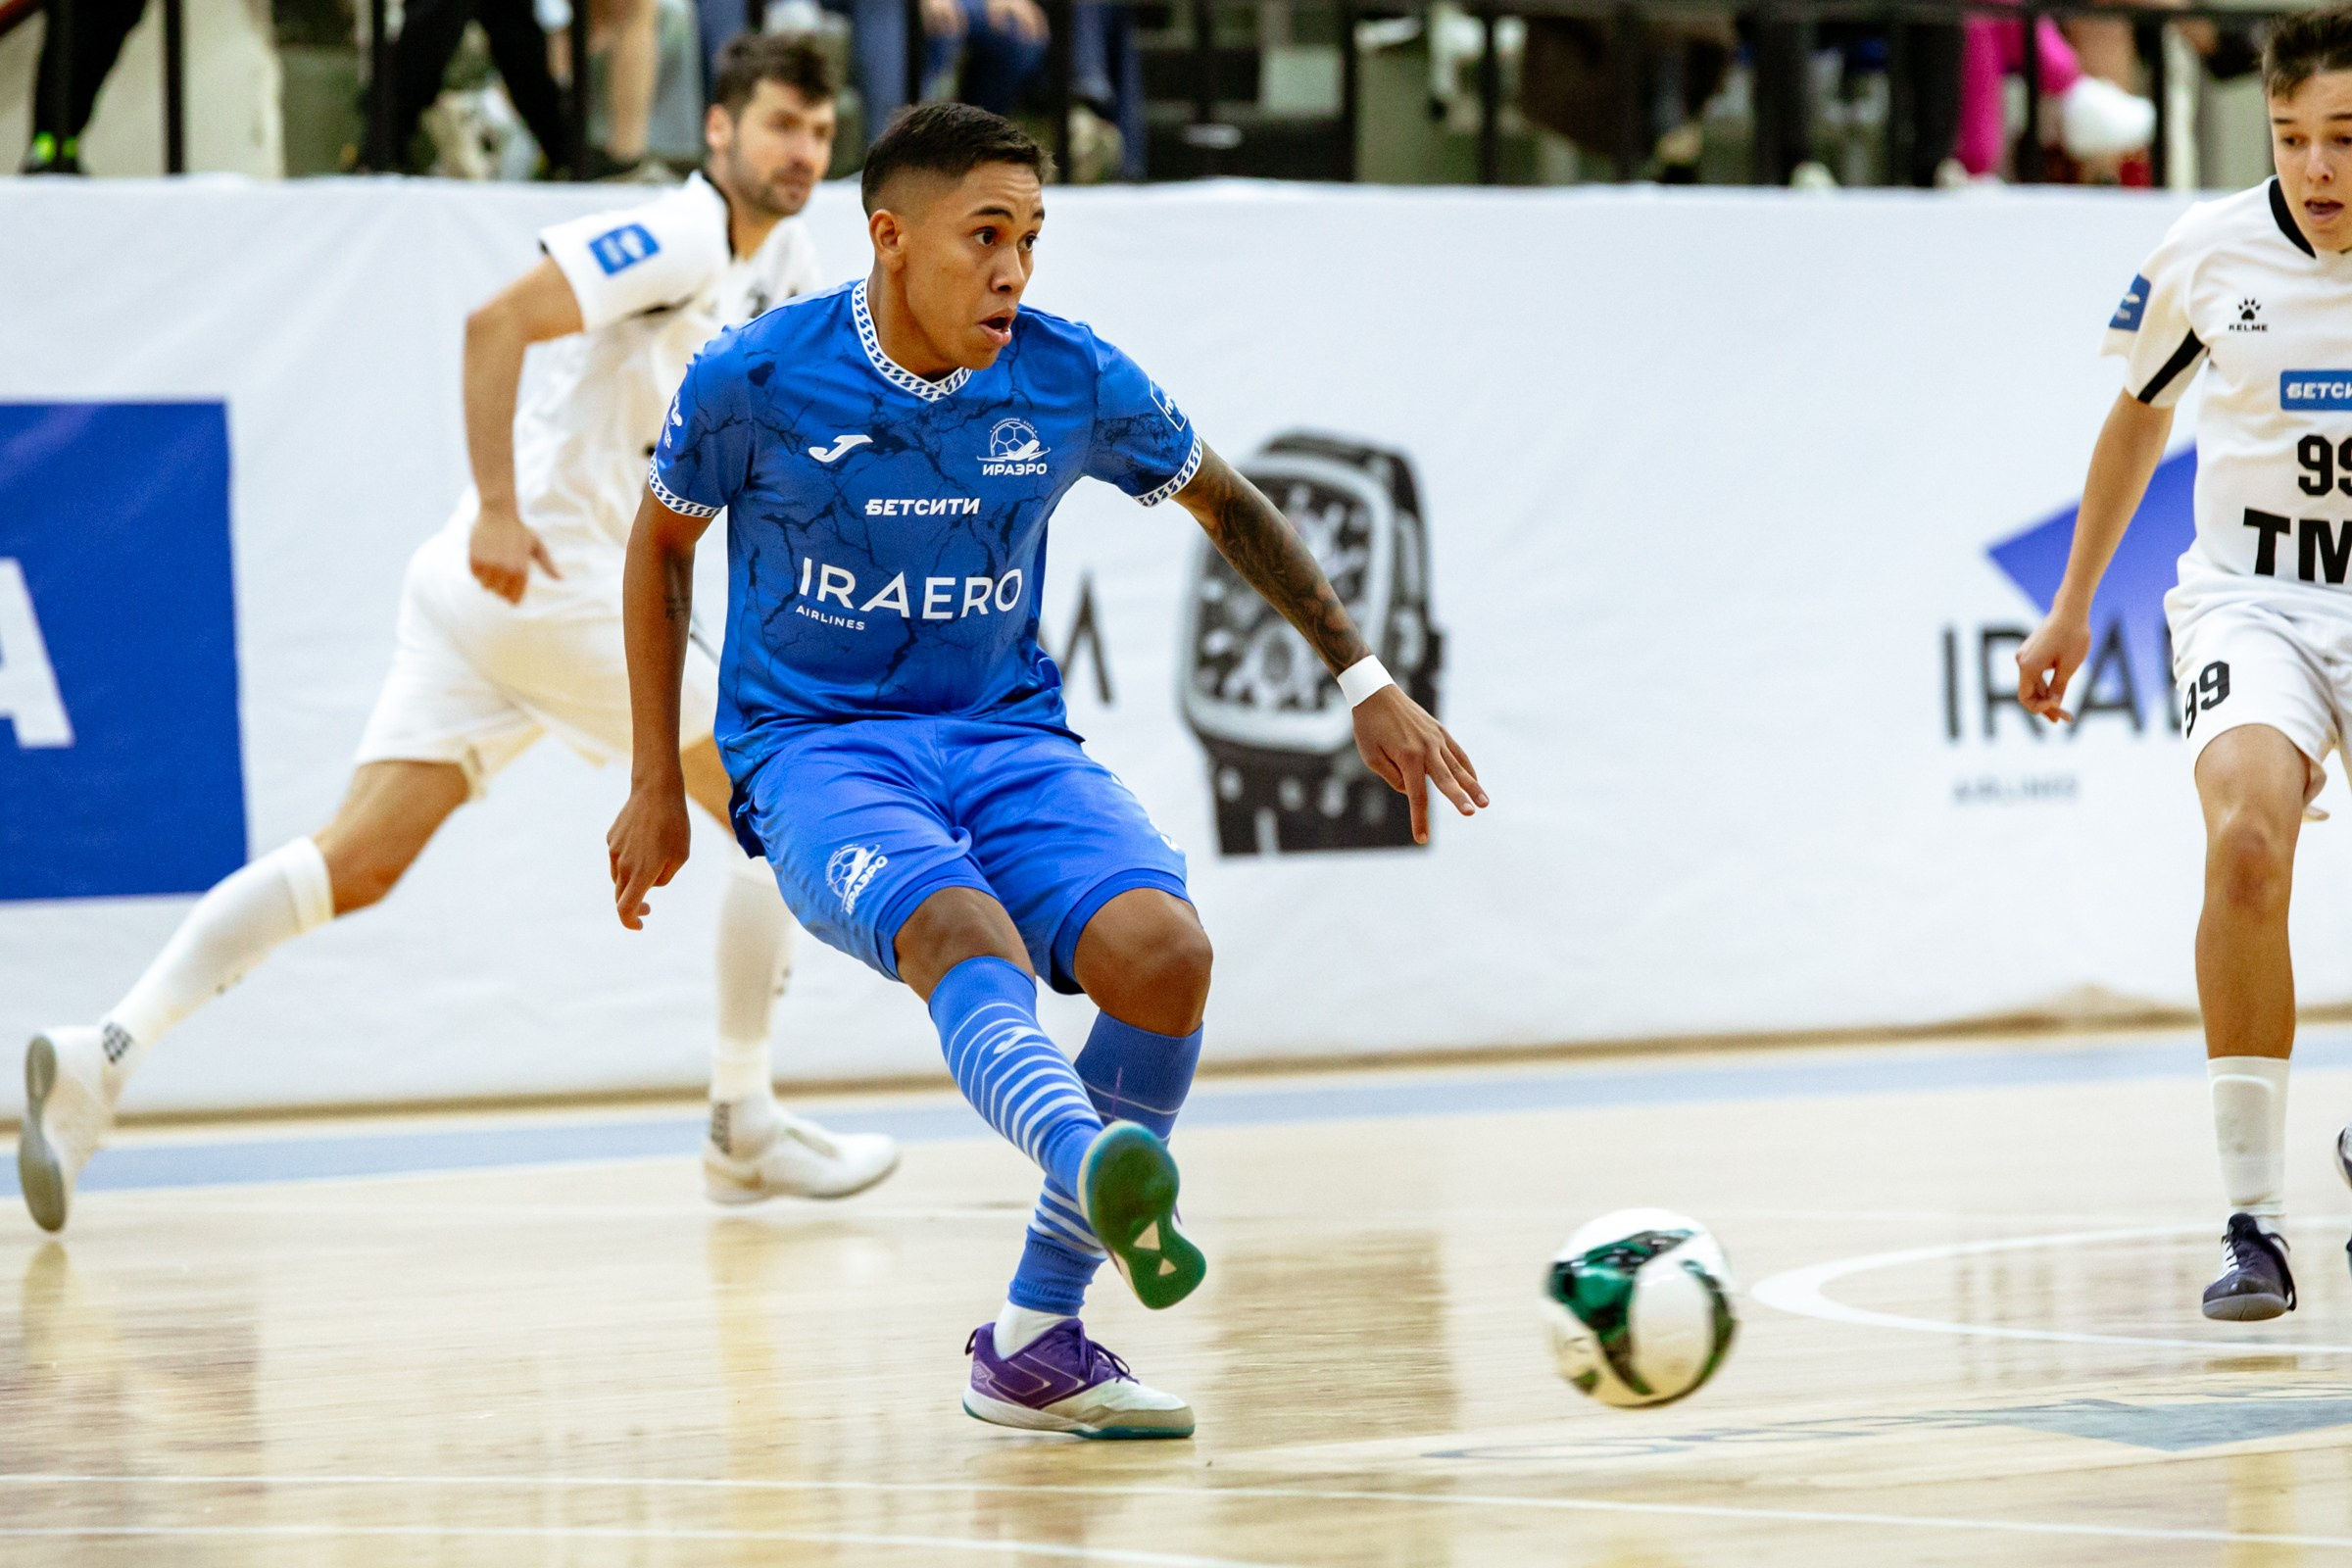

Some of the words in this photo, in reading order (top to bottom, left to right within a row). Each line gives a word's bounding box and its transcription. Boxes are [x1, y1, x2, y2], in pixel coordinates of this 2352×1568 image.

[2229, 323, 2269, 332] KELME
[982, 463, 1048, 476] ИРАЭРО
[864, 497, 980, 515] БЕТСИТИ
[799, 557, 1023, 619] IRAERO
[796, 605, 865, 631] AIRLINES
[2184, 661, 2230, 739] 99
[845, 855, 889, 915] ИРАЭРО
